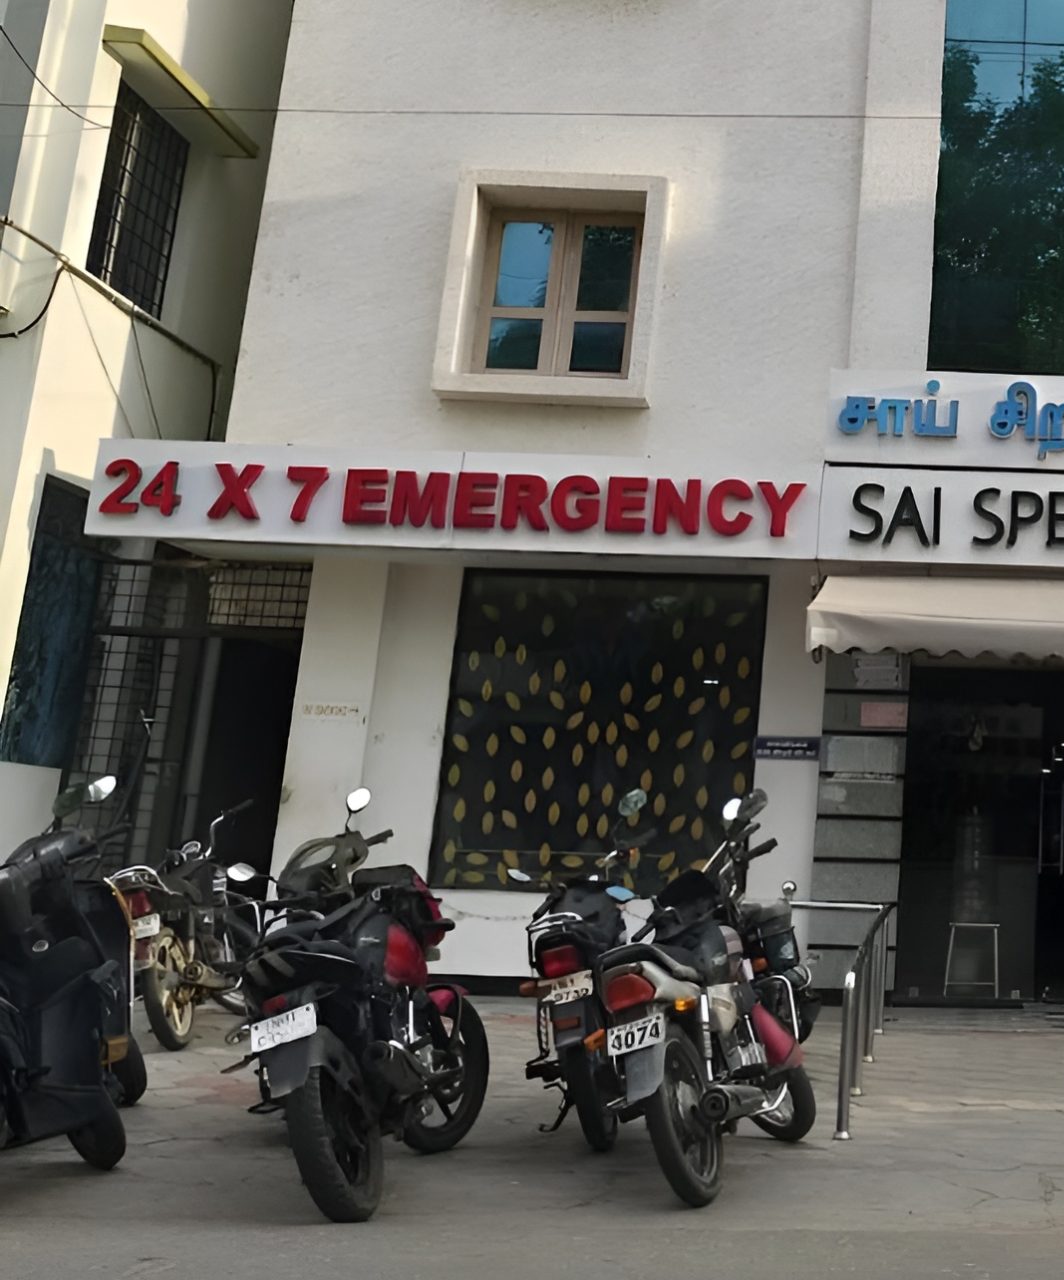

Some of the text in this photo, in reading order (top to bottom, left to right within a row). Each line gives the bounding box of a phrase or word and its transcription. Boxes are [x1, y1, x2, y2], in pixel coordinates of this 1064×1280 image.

[838, 379, 959, 438] சாய்
[99, 458, 807, 537] 24 X 7 EMERGENCY
[849, 483, 942, 548] SAI
